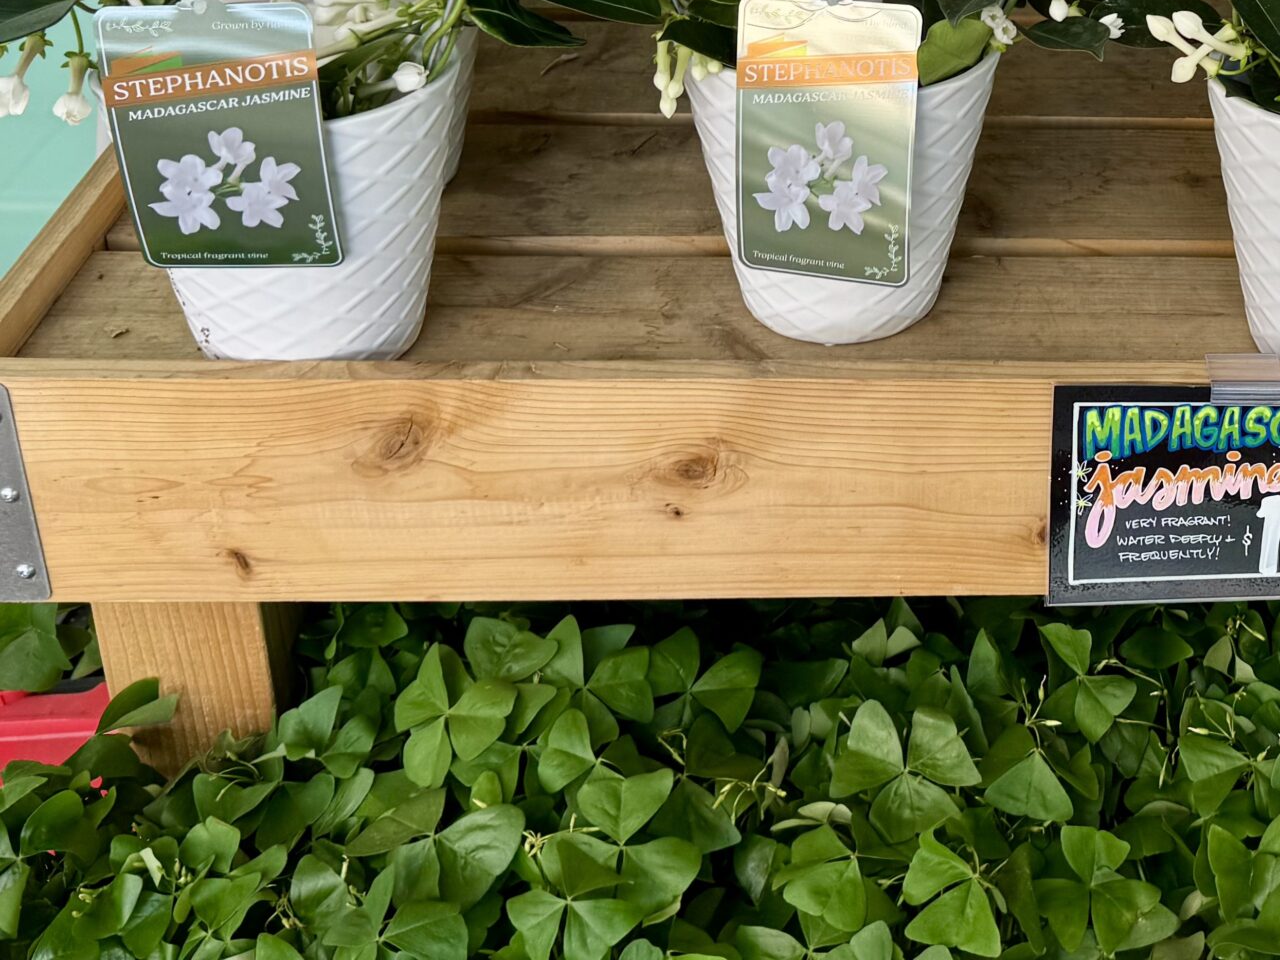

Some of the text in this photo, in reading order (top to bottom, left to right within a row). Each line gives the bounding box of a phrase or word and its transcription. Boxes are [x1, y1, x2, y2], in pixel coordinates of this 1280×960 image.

[211, 20, 249, 31] Grown
[251, 20, 265, 31] by
[744, 58, 913, 83] STEPHANOTIS
[114, 57, 309, 100] STEPHANOTIS
[128, 87, 311, 121] MADAGASCAR JASMINE
[753, 90, 846, 105] MADAGASCAR
[160, 252, 201, 260] Tropical
[203, 252, 245, 260] fragrant
[753, 250, 845, 269] Tropical fragrant vine
[1125, 514, 1231, 529] VERY FRAGRANT!
[1116, 535, 1165, 546] WATER
[1169, 534, 1223, 546] DEEPLY
[1118, 547, 1220, 562] FREQUENTLY!
